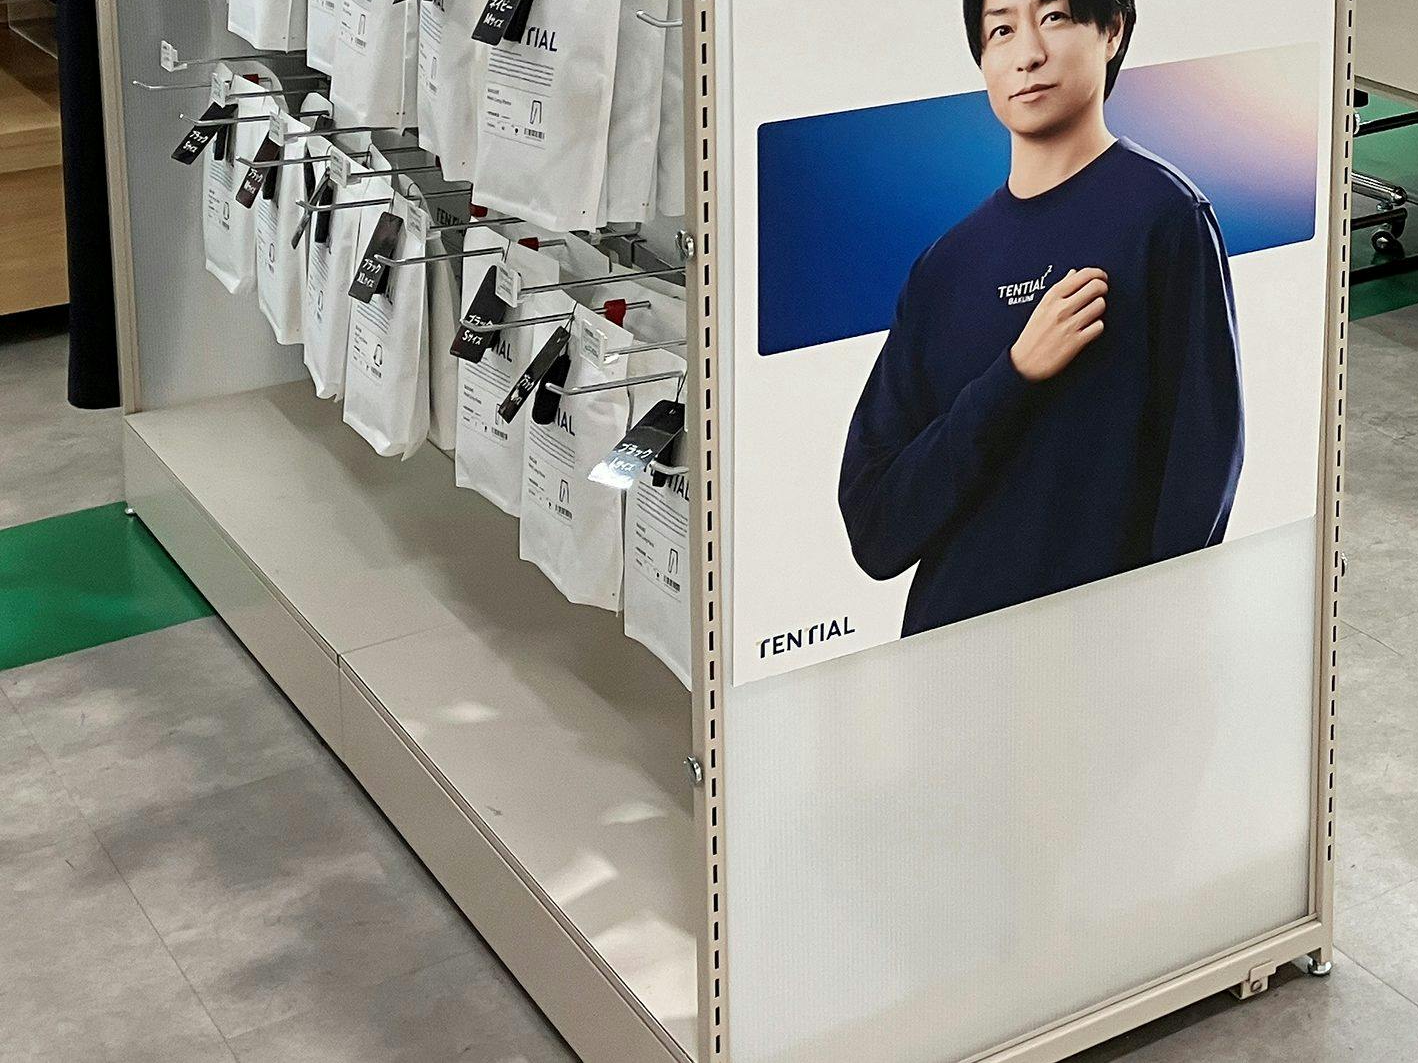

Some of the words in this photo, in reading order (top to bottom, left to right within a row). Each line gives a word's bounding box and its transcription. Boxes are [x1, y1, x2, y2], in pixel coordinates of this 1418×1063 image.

[526, 26, 558, 52] TIAL
[362, 257, 382, 274] ブラック
[997, 276, 1047, 299] TENTIAL
[1007, 293, 1035, 306] BAKUNE
[462, 329, 484, 346] Sサイズ
[620, 442, 654, 460] ブラック
[757, 616, 856, 659] TENTIAL
